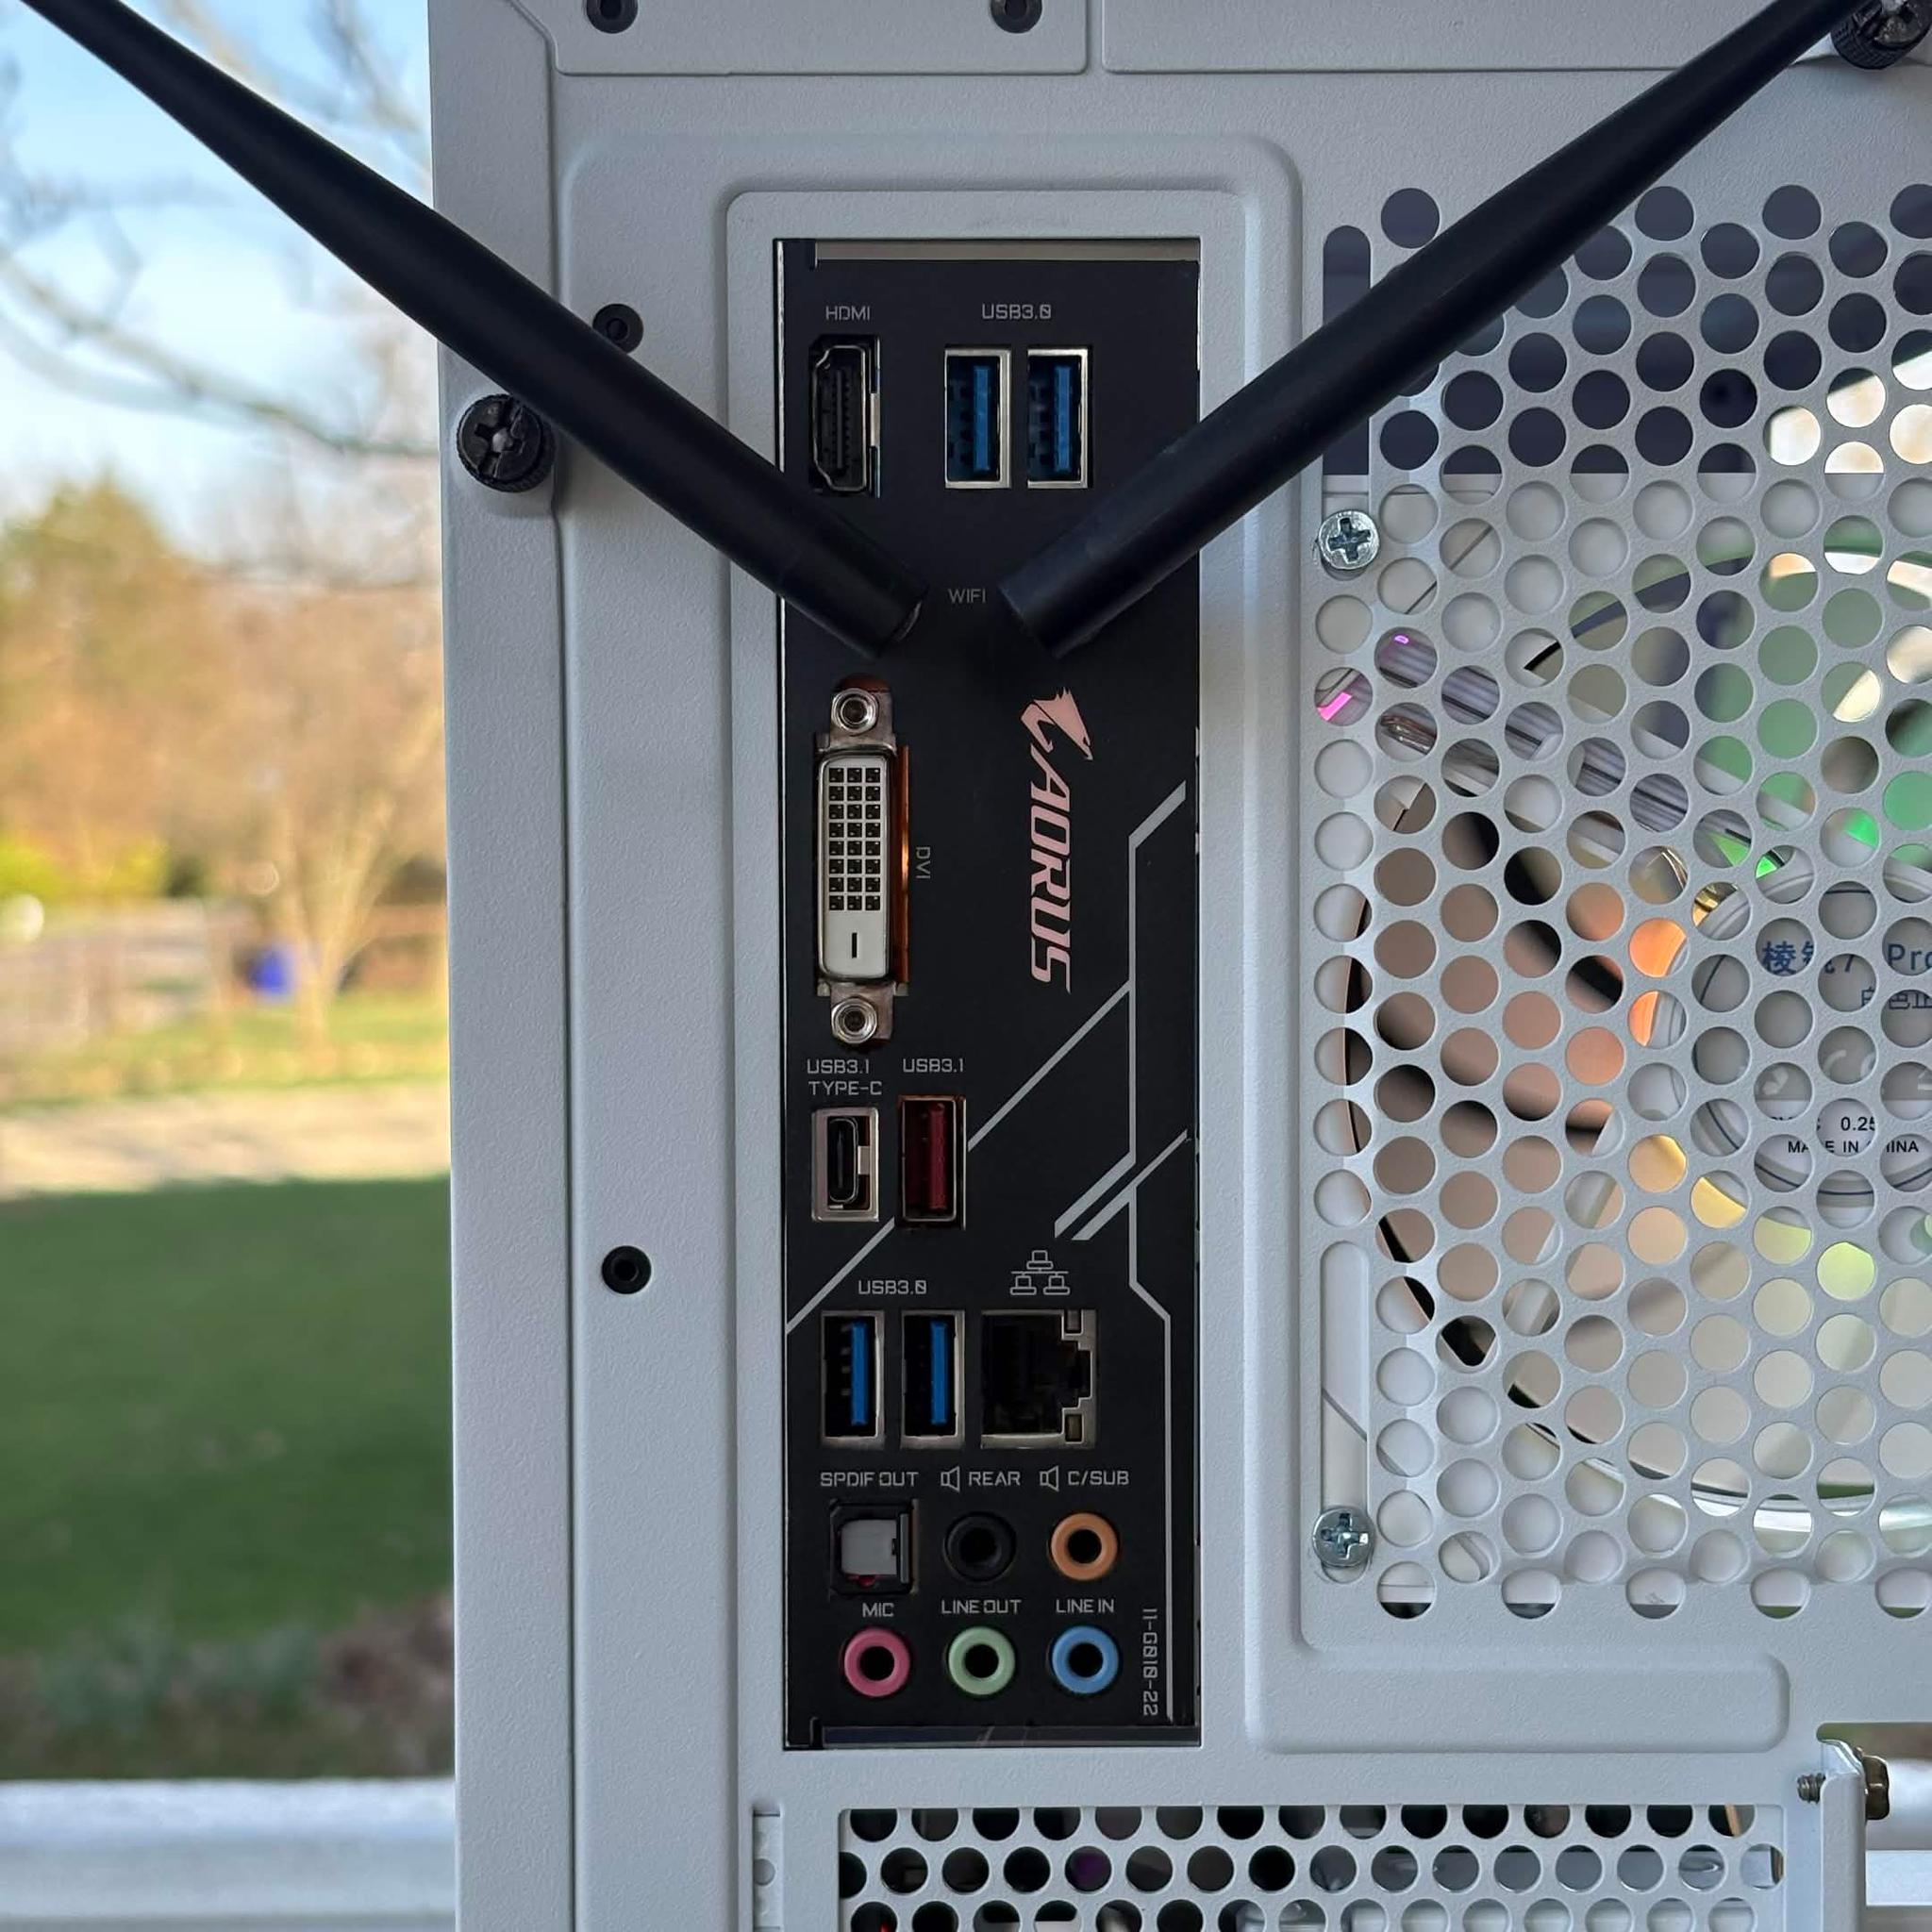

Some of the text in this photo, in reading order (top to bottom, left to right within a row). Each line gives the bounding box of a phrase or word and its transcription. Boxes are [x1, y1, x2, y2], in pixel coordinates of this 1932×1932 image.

[825, 305, 871, 321] HDMI
[981, 303, 1052, 320] USB3.0
[947, 588, 987, 604] WIFI
[915, 845, 931, 879] DVI
[1030, 742, 1072, 994] AORUS
[807, 1058, 870, 1074] USB3.1
[902, 1058, 964, 1073] USB3.1
[808, 1080, 883, 1096] TYPE-C
[1788, 1141, 1835, 1153] MAE
[1842, 1141, 1859, 1153] IN
[858, 1279, 927, 1295] USB3.0
[820, 1472, 920, 1487] SPDIF OUT
[968, 1471, 1021, 1487] REAR
[1067, 1470, 1130, 1486] C/SUB
[861, 1602, 895, 1617] MIC
[941, 1599, 1023, 1614] LINE OUT
[1055, 1598, 1115, 1613] LINE IN
